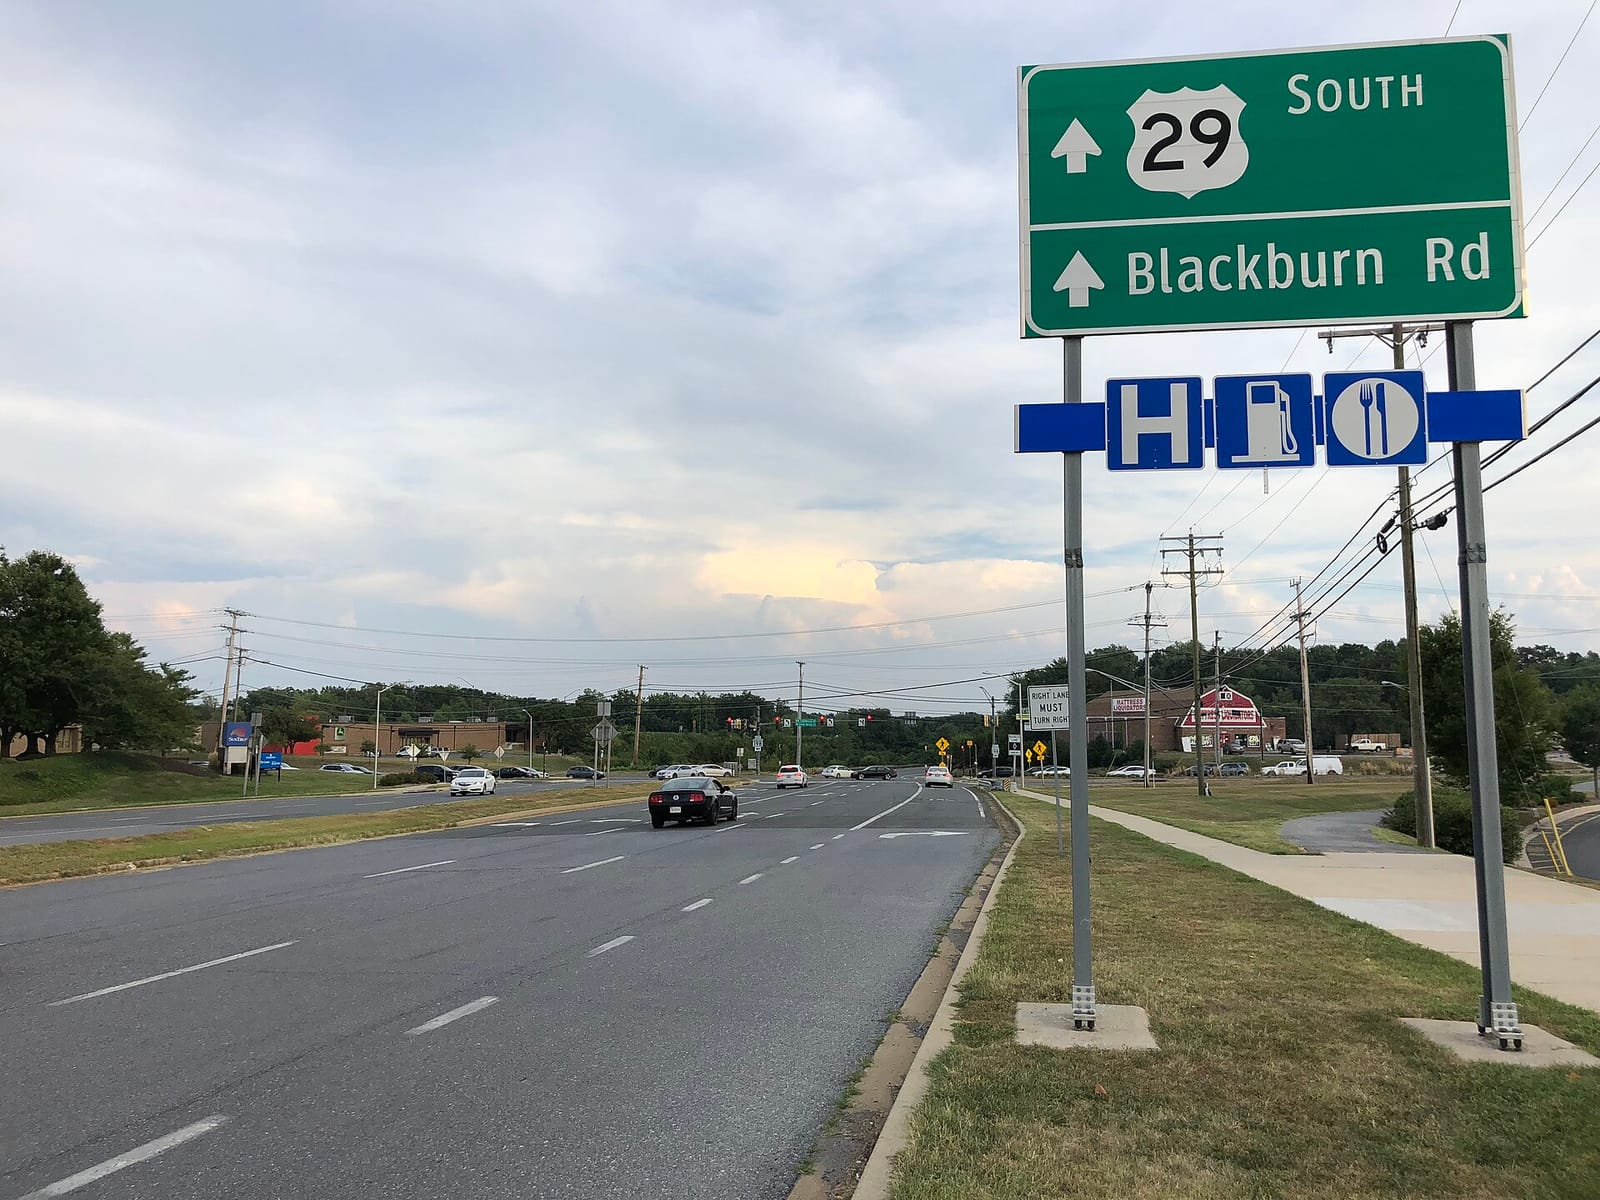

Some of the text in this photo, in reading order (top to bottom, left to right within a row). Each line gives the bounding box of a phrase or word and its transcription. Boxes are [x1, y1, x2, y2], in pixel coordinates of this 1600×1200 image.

[1287, 73, 1424, 115] SOUTH
[1142, 109, 1231, 172] 29
[1127, 231, 1490, 296] Blackburn Rd
[1120, 382, 1189, 464] H
[1031, 691, 1070, 700] RIGHT LANE
[1039, 703, 1063, 712] MUST
[1034, 716, 1050, 724] TURN
